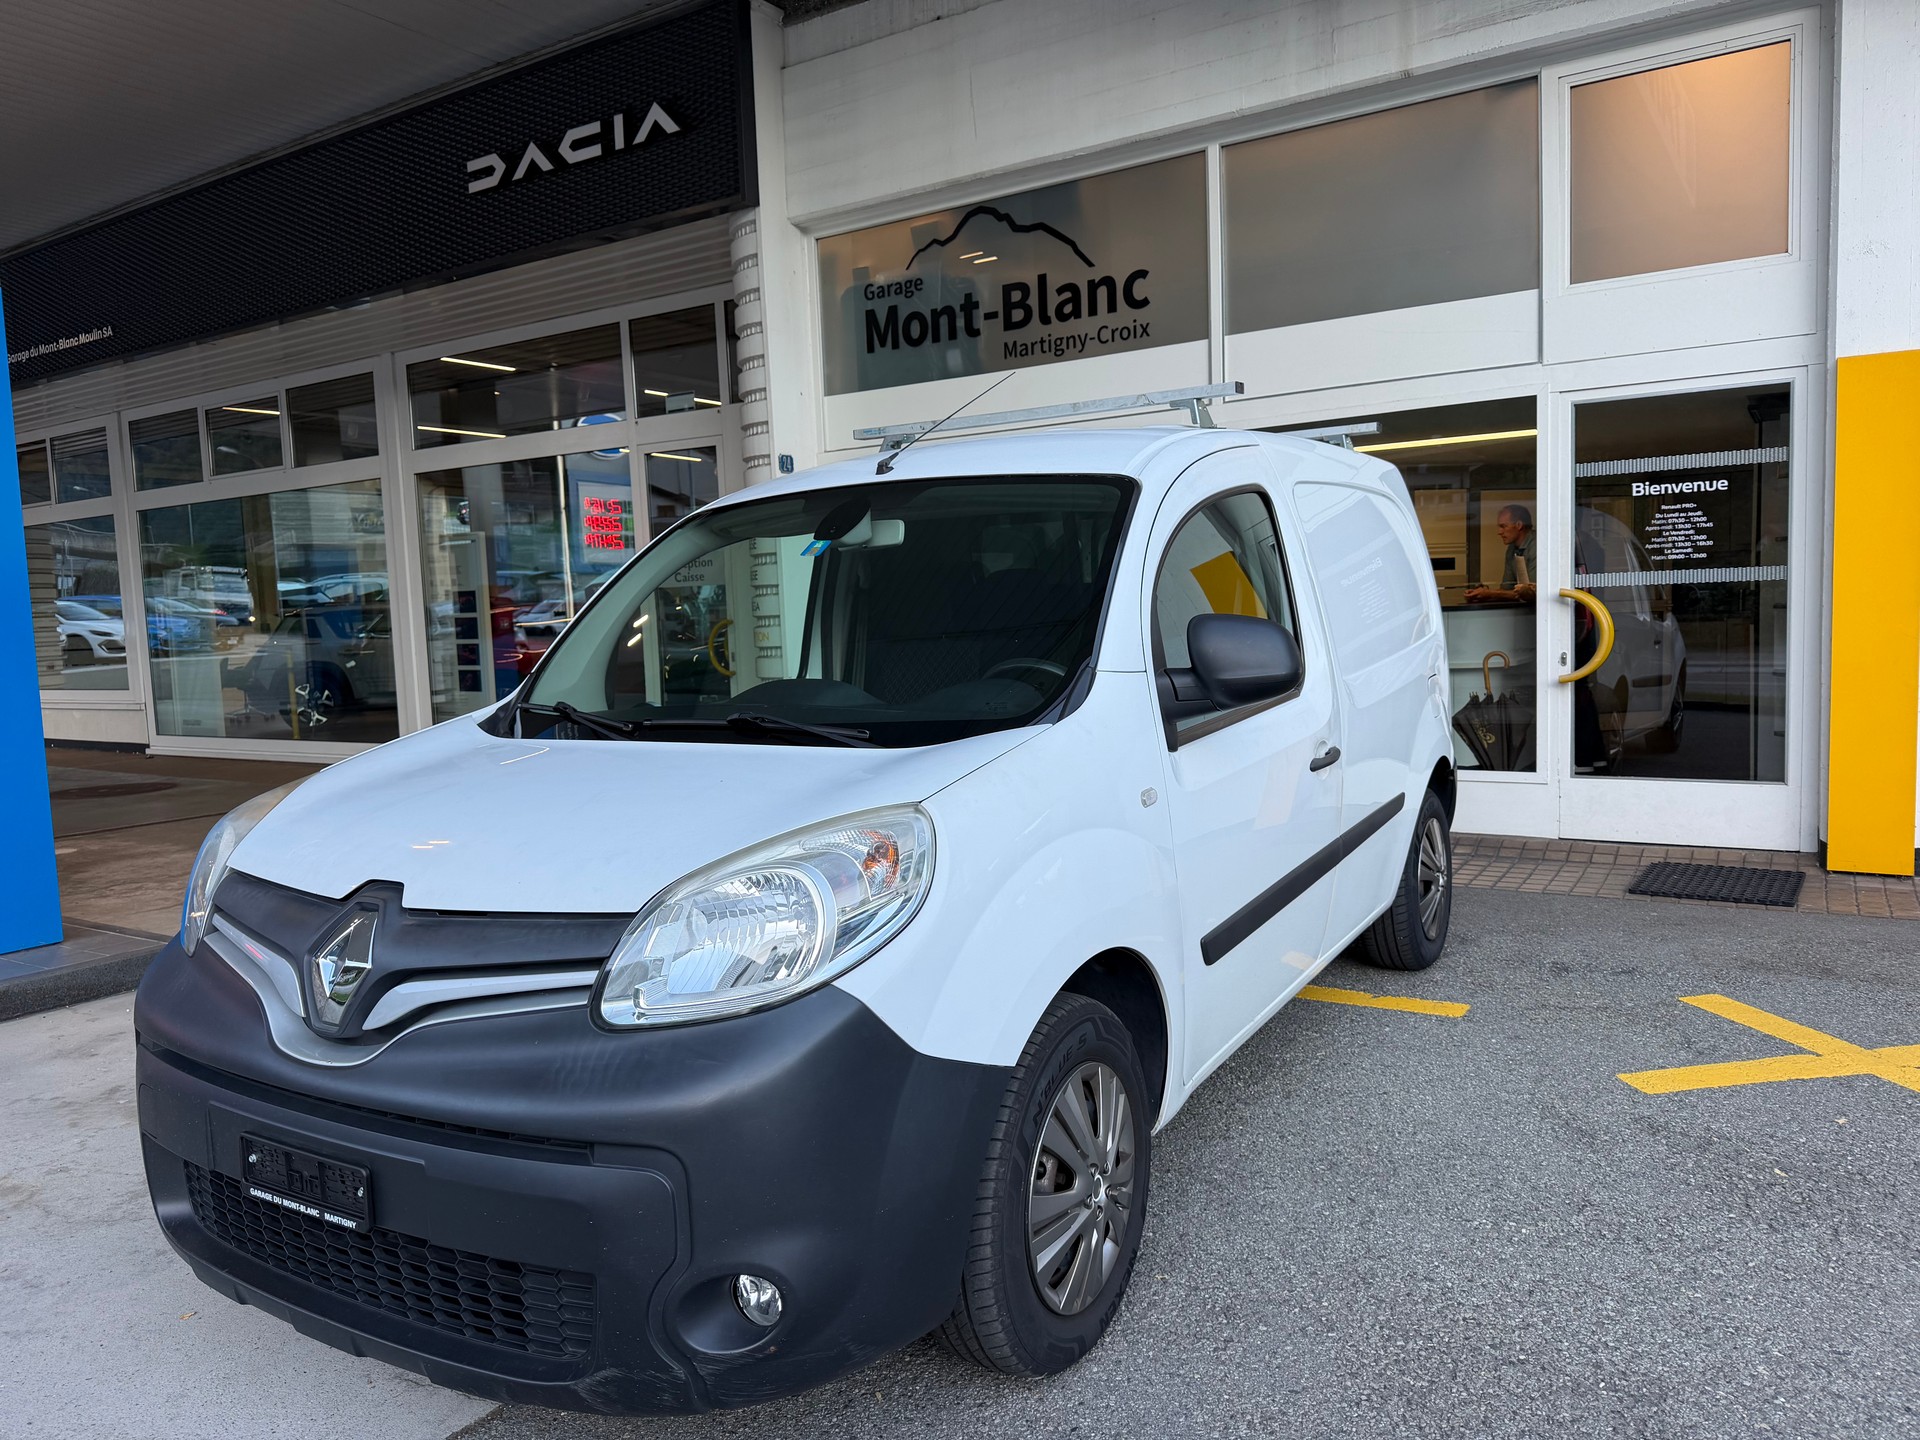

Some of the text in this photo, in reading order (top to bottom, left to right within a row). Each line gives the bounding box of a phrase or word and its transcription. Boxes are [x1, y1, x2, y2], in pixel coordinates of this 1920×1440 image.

[466, 101, 681, 194] DACIA
[863, 277, 924, 301] Garage
[865, 268, 1151, 354] Mont-Blanc
[30, 346, 39, 357] du
[39, 336, 79, 355] Mont-Blanc
[79, 328, 102, 345] Moulin
[102, 325, 113, 338] SA
[1003, 321, 1151, 360] Martigny-Croix
[1631, 479, 1729, 497] Bienvenue
[674, 572, 705, 582] Caisse
[250, 1187, 356, 1228] GARAGE DU MONT-BLANC MARTIGNY
